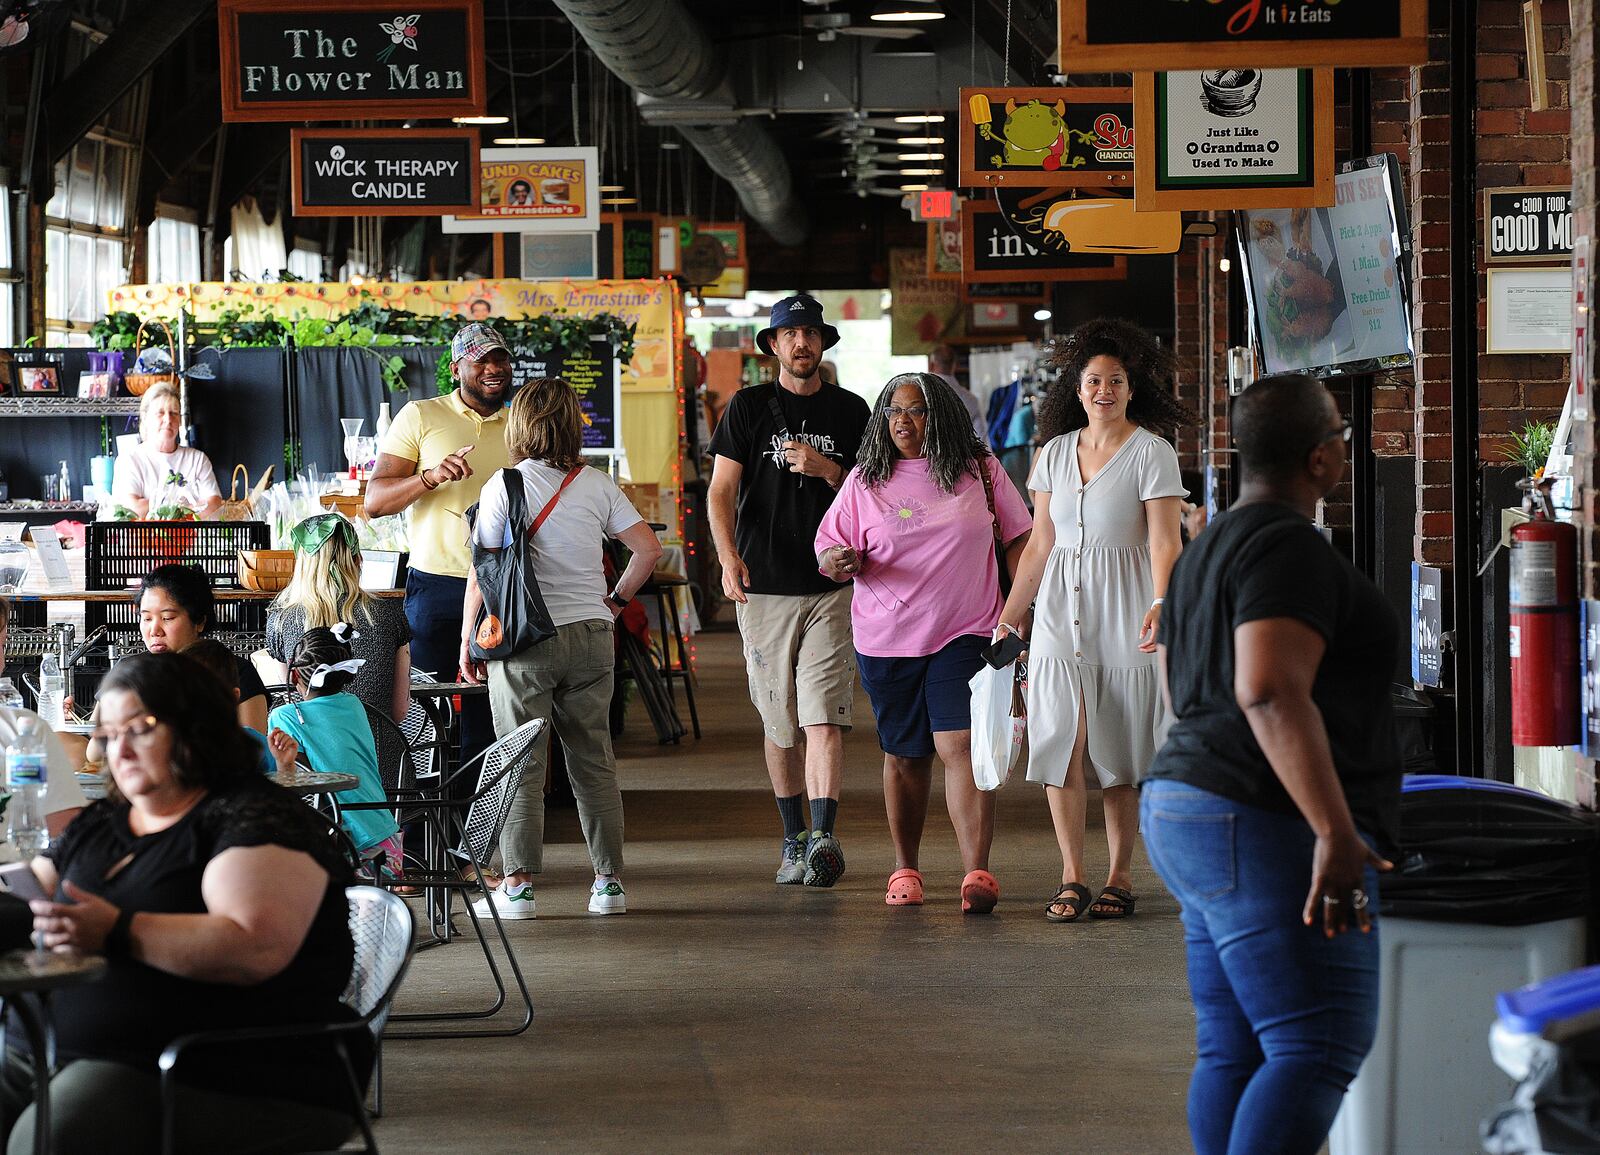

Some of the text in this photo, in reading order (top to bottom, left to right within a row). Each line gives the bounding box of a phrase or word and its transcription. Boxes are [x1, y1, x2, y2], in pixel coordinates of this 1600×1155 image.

[1265, 5, 1275, 24] It
[1300, 5, 1331, 24] Eats
[284, 29, 358, 58] The
[244, 64, 464, 92] Flower Man
[1206, 126, 1259, 138] Just Like
[1200, 141, 1265, 154] Grandma
[315, 160, 459, 177] WICK THERAPY
[1192, 157, 1274, 168] Used To Make
[482, 164, 582, 184] UND CAKES
[351, 182, 426, 199] CANDLE
[1335, 181, 1355, 206] UN
[482, 205, 574, 215] rs. Ernestine's
[921, 191, 954, 218] EXIT
[1522, 196, 1566, 213] GOOD FOOD
[1339, 222, 1383, 240] Pick 2 Apps
[1491, 214, 1539, 252] GOOD
[1359, 255, 1380, 270] Main
[517, 288, 663, 308] Mrs. Ernestine's
[1351, 287, 1391, 305] Free Drink
[1368, 319, 1382, 331] $12
[519, 360, 547, 370] Therapy
